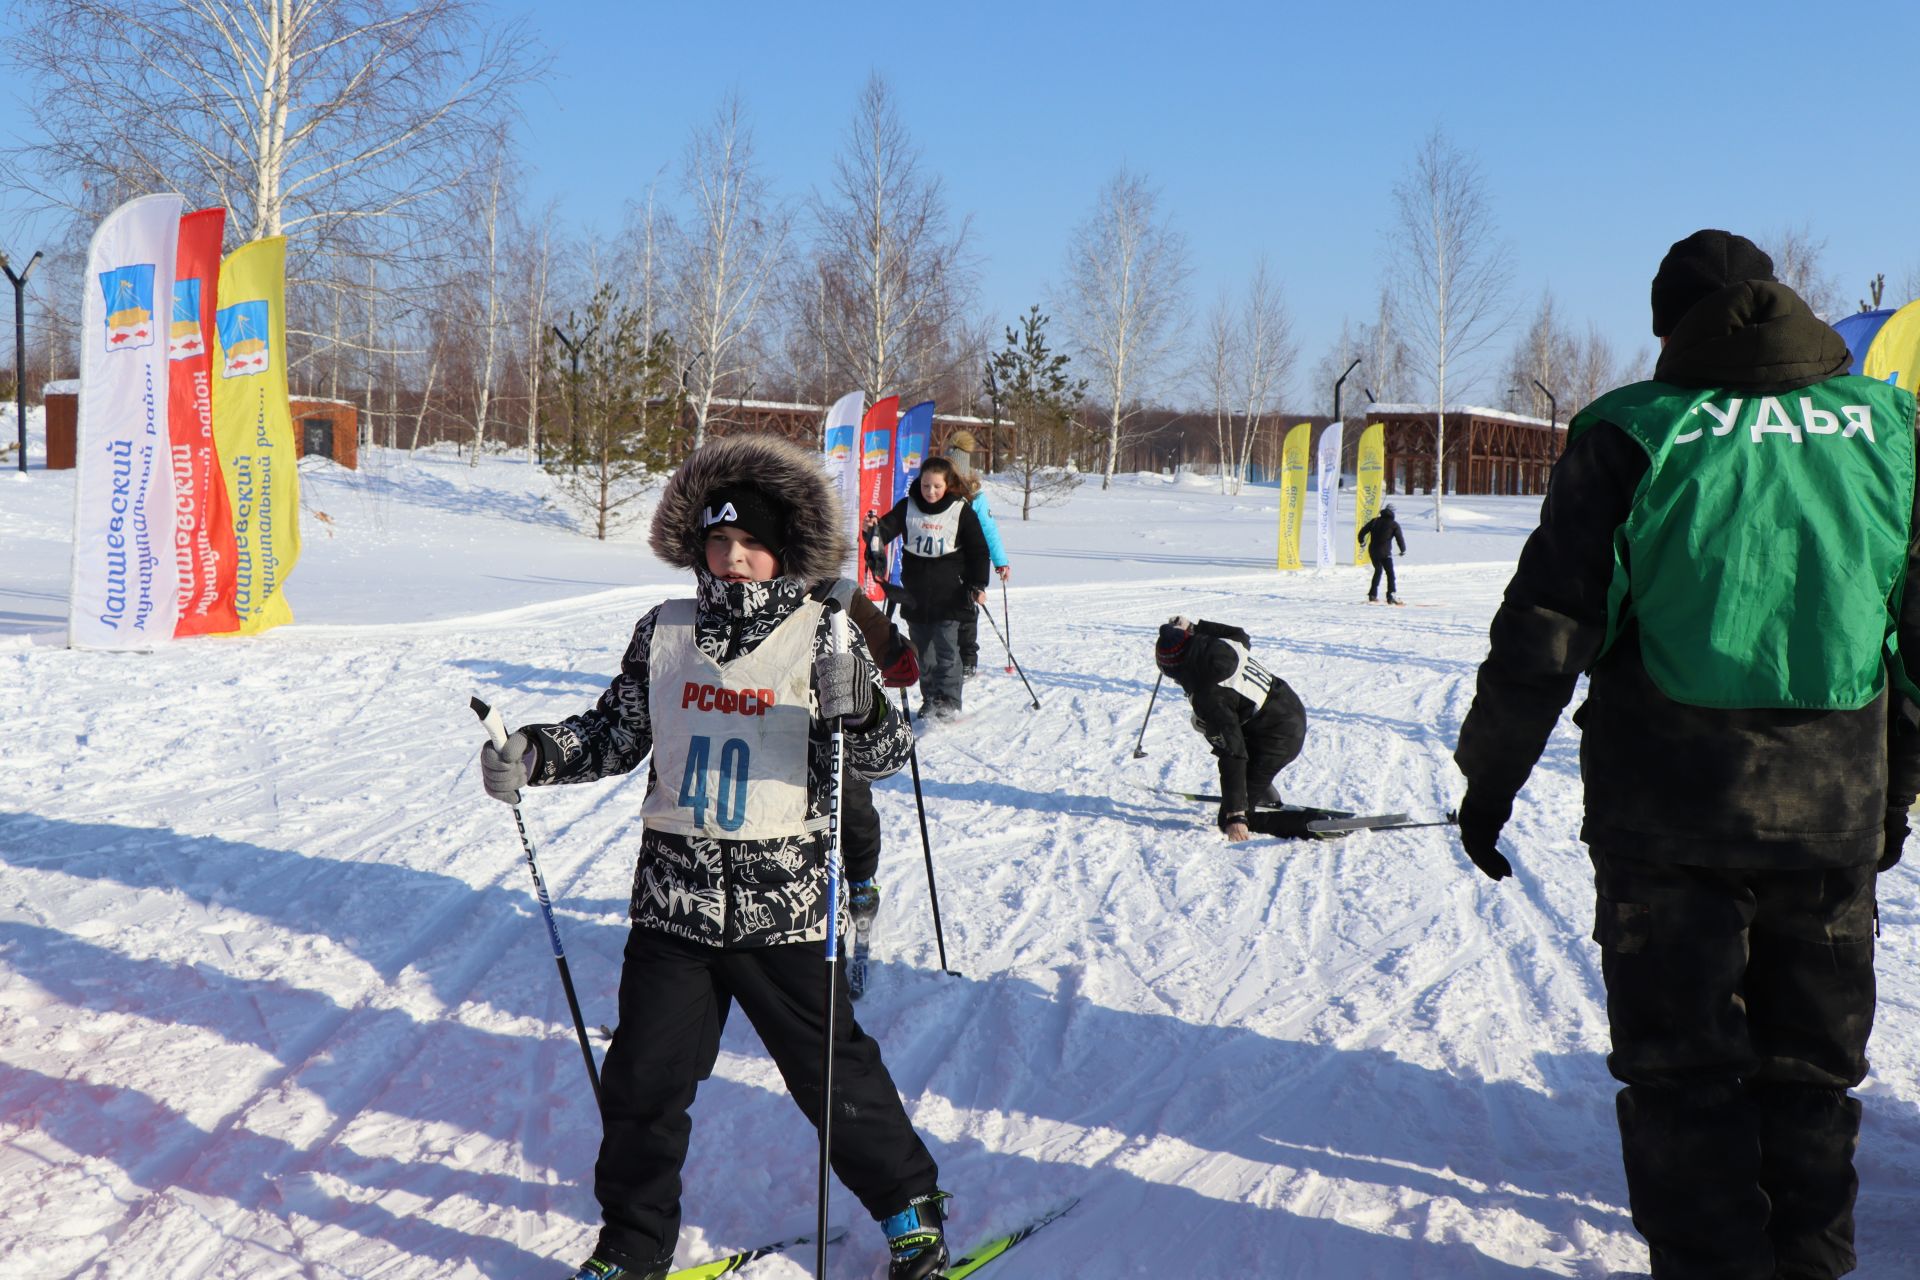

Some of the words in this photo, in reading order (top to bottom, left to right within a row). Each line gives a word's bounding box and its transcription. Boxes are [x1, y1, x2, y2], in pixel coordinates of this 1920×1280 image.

[143, 364, 157, 435] район
[100, 440, 132, 629] Лаишевский
[133, 446, 159, 630] муниципальный
[254, 456, 279, 614] ниципальный
[703, 502, 738, 528] ILA
[915, 535, 945, 555] 141
[682, 682, 775, 716] РСФСР
[678, 735, 750, 832] 40
[909, 1194, 930, 1206] REK
